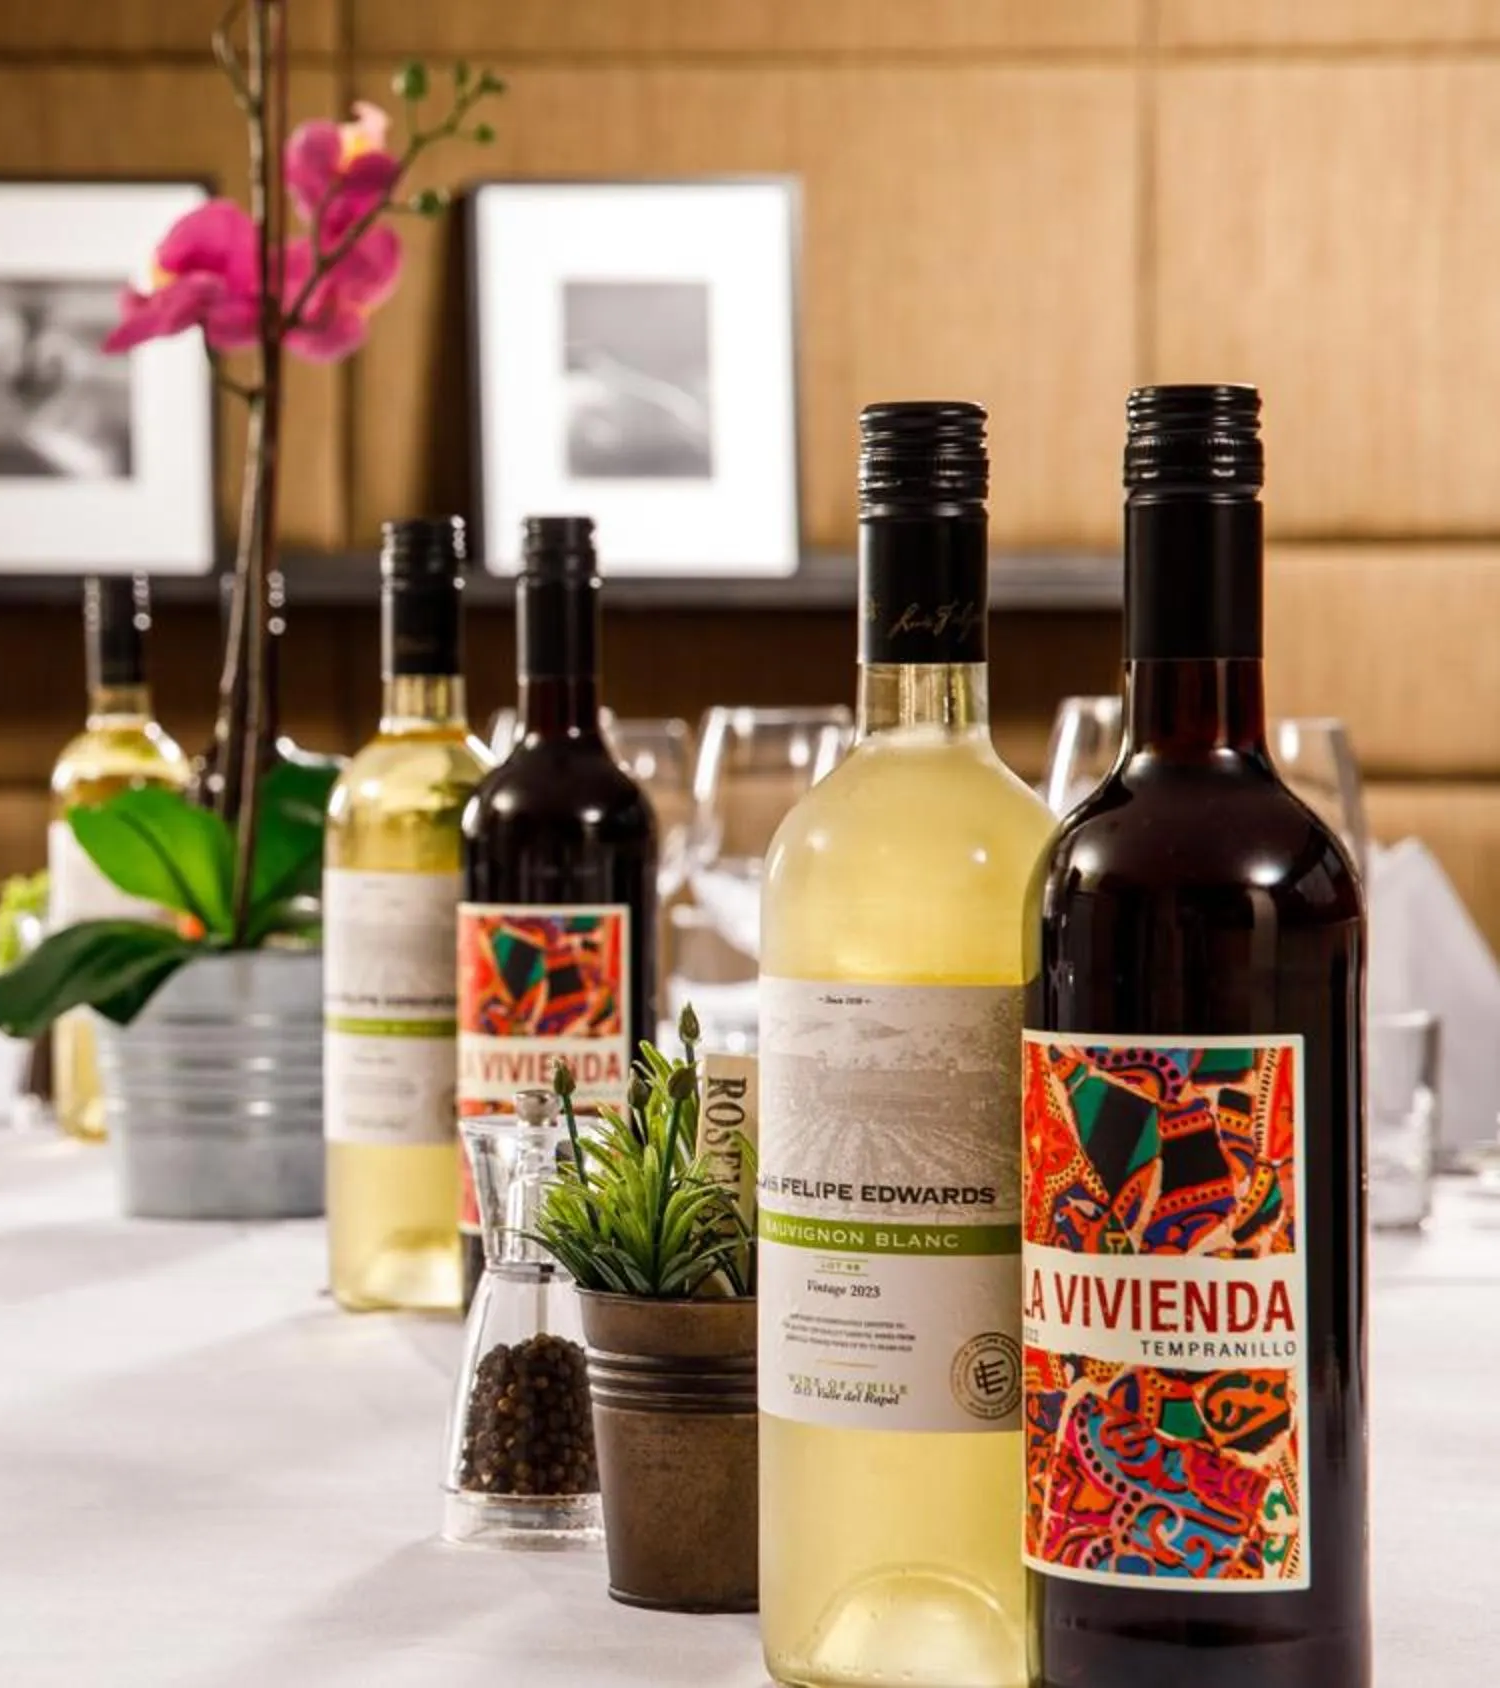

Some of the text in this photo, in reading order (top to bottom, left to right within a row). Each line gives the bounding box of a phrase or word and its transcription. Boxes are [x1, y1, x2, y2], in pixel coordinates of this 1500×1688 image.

[781, 1177, 853, 1201] FELIPE
[861, 1184, 996, 1205] EDWARDS
[875, 1233, 960, 1249] BLANC
[807, 1279, 882, 1298] Vintage 2023
[1053, 1271, 1296, 1334] VIVIENDA
[1141, 1340, 1297, 1358] TEMPRANILLO
